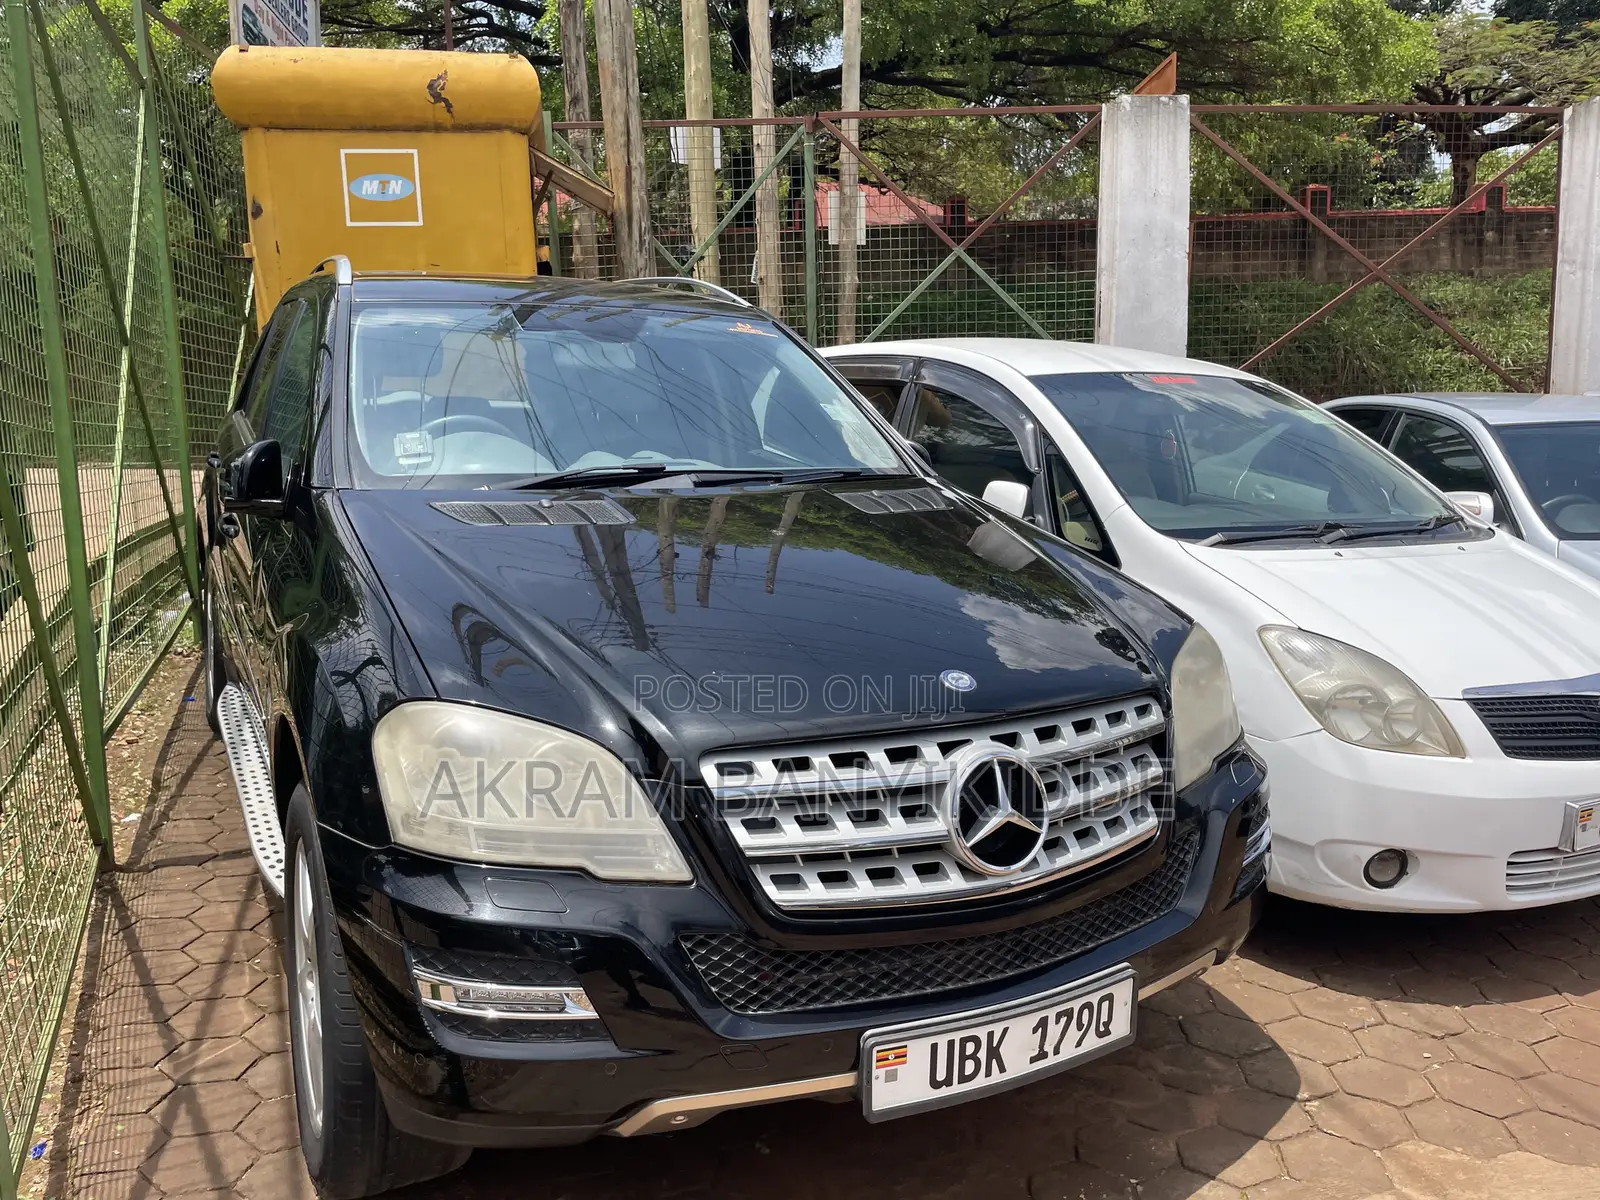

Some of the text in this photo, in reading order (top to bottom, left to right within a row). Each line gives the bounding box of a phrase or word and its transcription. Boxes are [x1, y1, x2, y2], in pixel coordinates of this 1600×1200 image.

[362, 180, 402, 194] MTN
[929, 992, 1115, 1090] UBK 179Q
